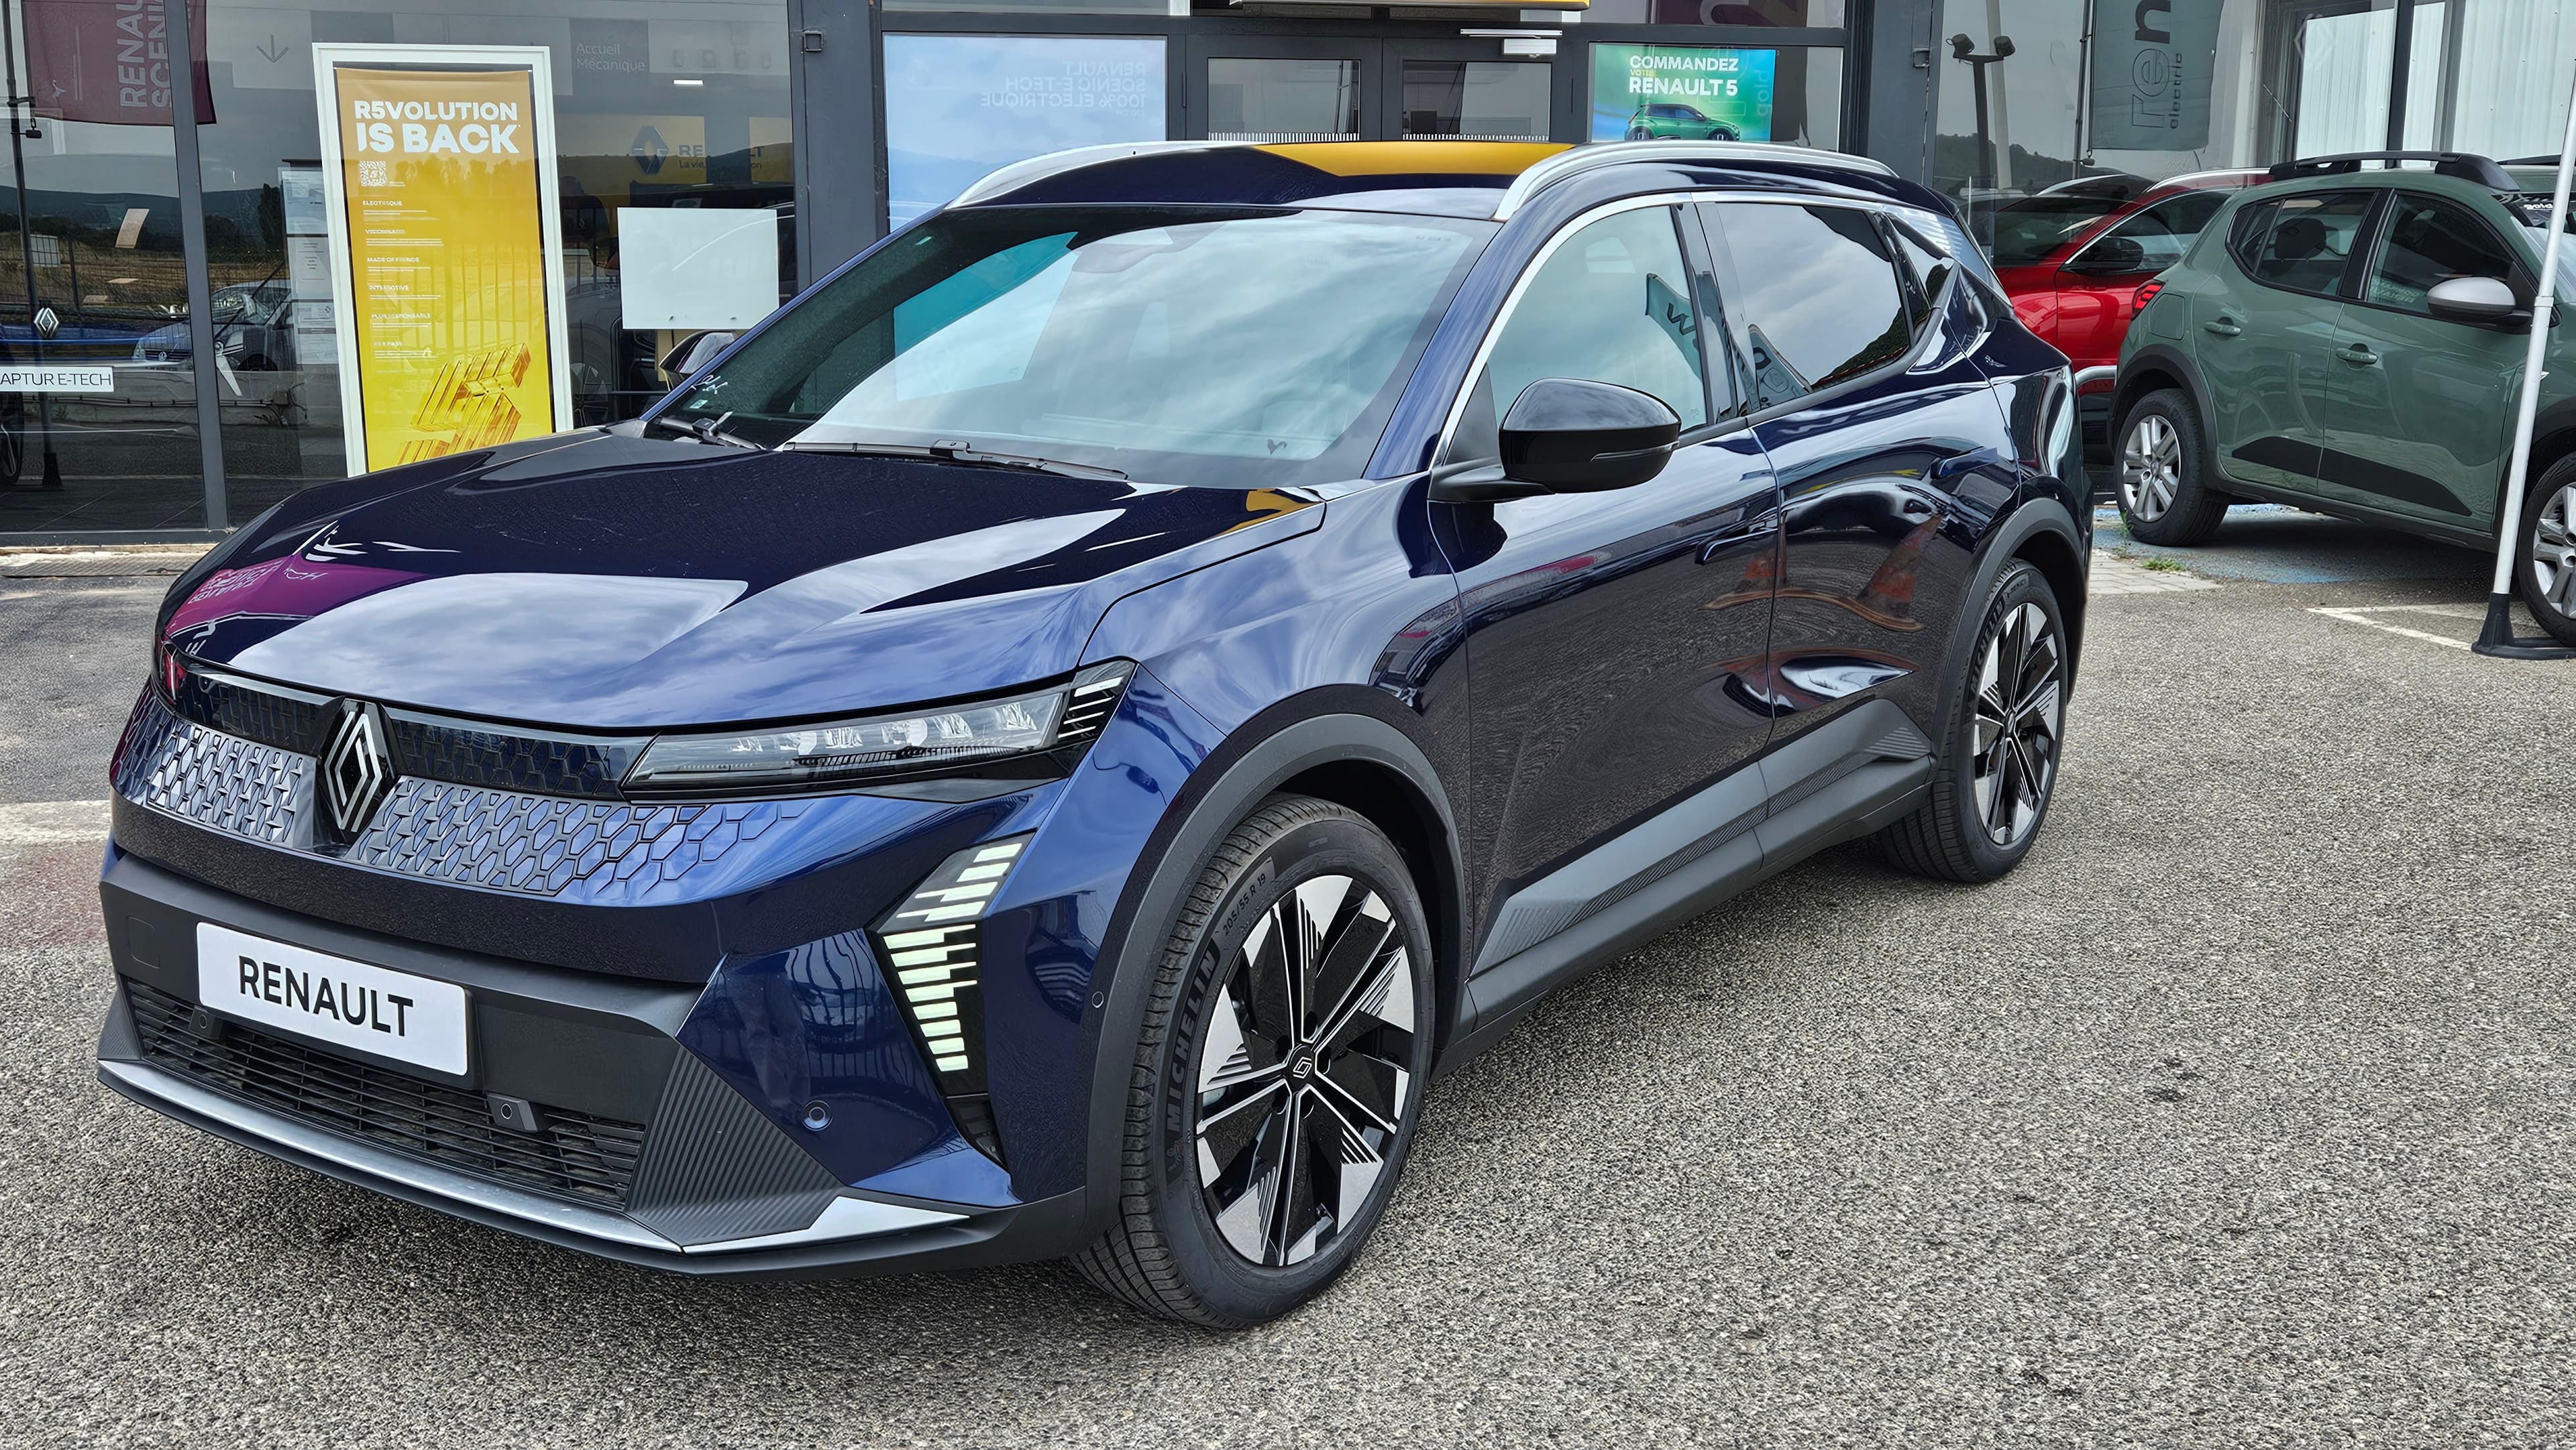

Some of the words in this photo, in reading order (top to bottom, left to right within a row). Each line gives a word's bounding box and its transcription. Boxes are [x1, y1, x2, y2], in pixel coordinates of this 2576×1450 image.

[146, 0, 172, 108] SCENI
[576, 42, 621, 54] Accueil
[1629, 55, 1739, 71] COMMANDEZ
[1629, 76, 1723, 96] RENAULT
[1726, 78, 1739, 97] 5
[2168, 53, 2183, 129] electric
[354, 101, 518, 121] R5VOLUTION
[356, 123, 394, 153] IS
[402, 123, 520, 154] BACK
[57, 373, 111, 386] E-TECH
[1223, 893, 1250, 936] 205/55
[1249, 885, 1256, 897] R
[1256, 873, 1266, 886] 19
[238, 954, 414, 1038] RENAULT
[1166, 948, 1217, 1133] MICHELIN
